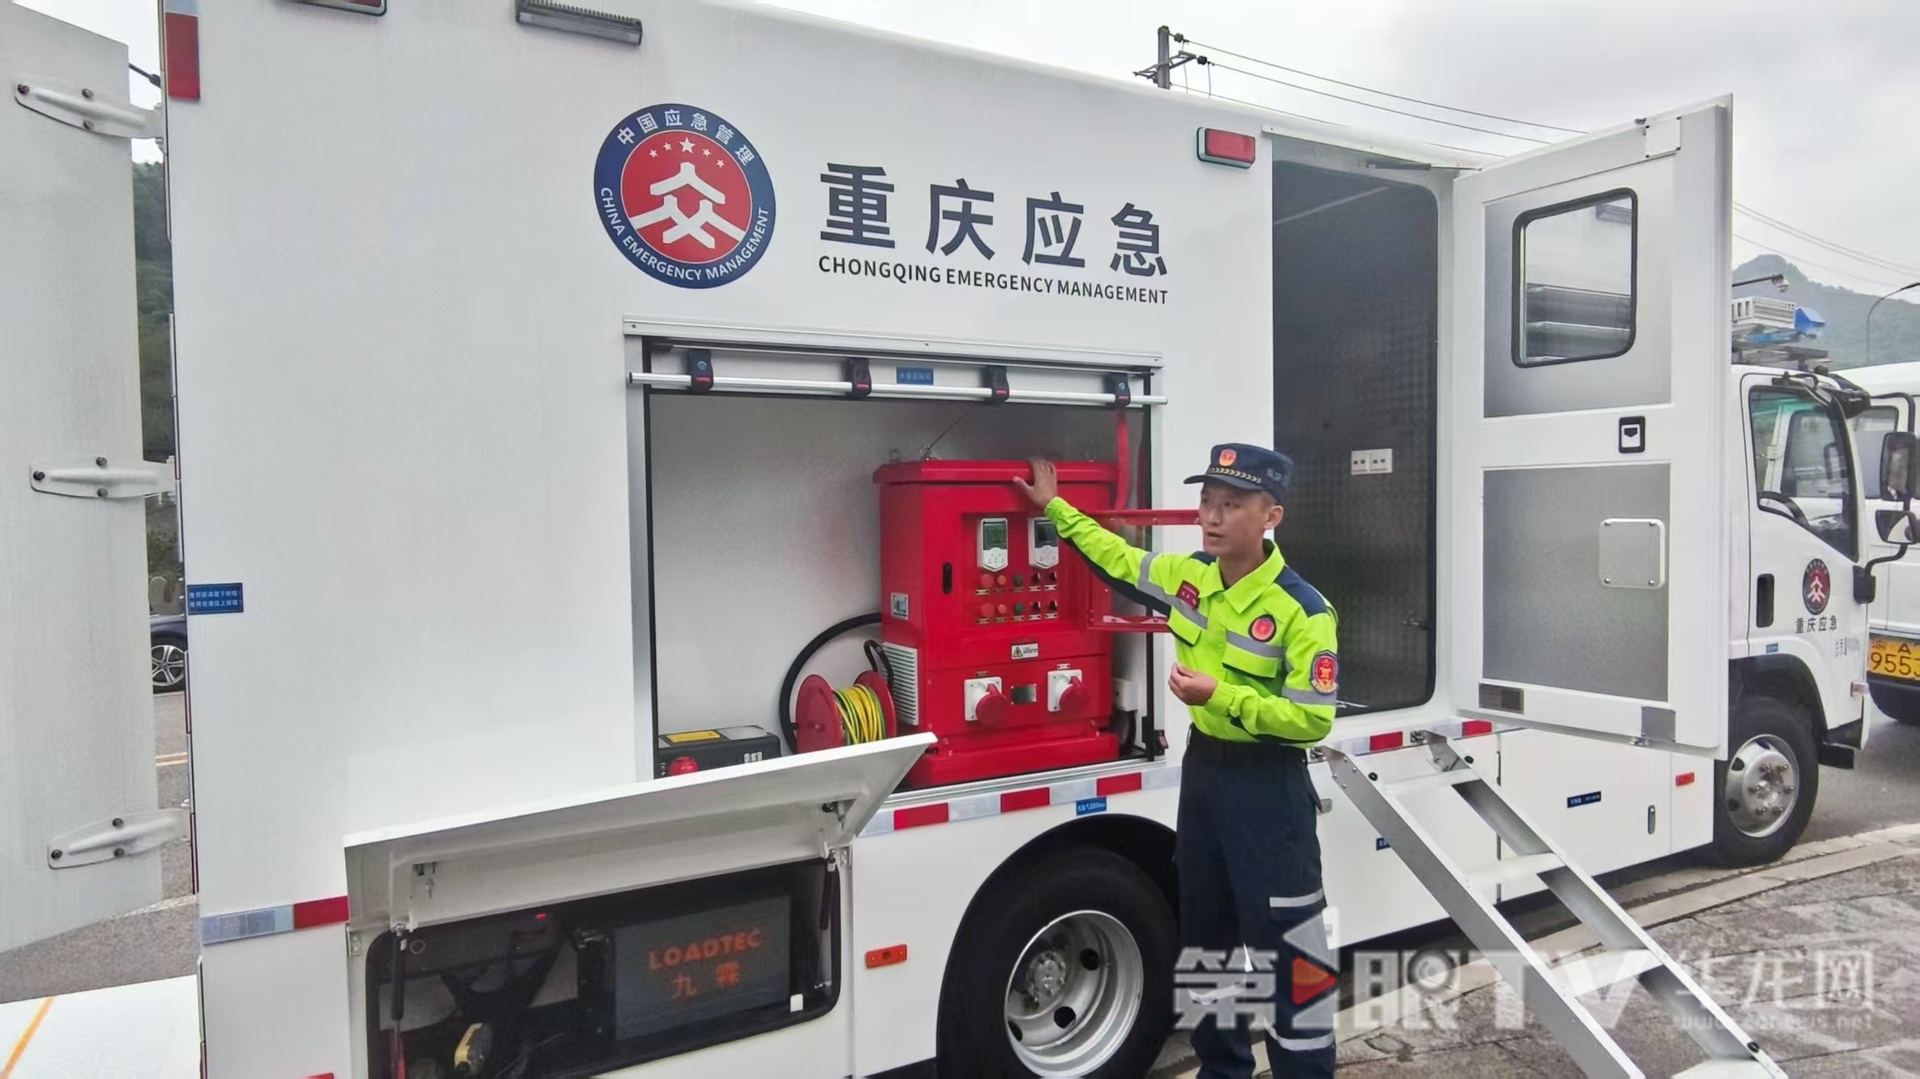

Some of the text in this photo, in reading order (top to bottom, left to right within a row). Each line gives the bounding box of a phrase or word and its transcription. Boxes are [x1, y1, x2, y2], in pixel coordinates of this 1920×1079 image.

[617, 109, 755, 166] 中国应急管理
[600, 187, 769, 281] CHINA EMERGENCY MANAGEMENT
[820, 162, 1168, 277] 重庆应急
[818, 255, 1168, 305] CHONGQING EMERGENCY MANAGEMENT
[1795, 615, 1837, 634] 重庆应急
[648, 928, 763, 970] LOADTEC
